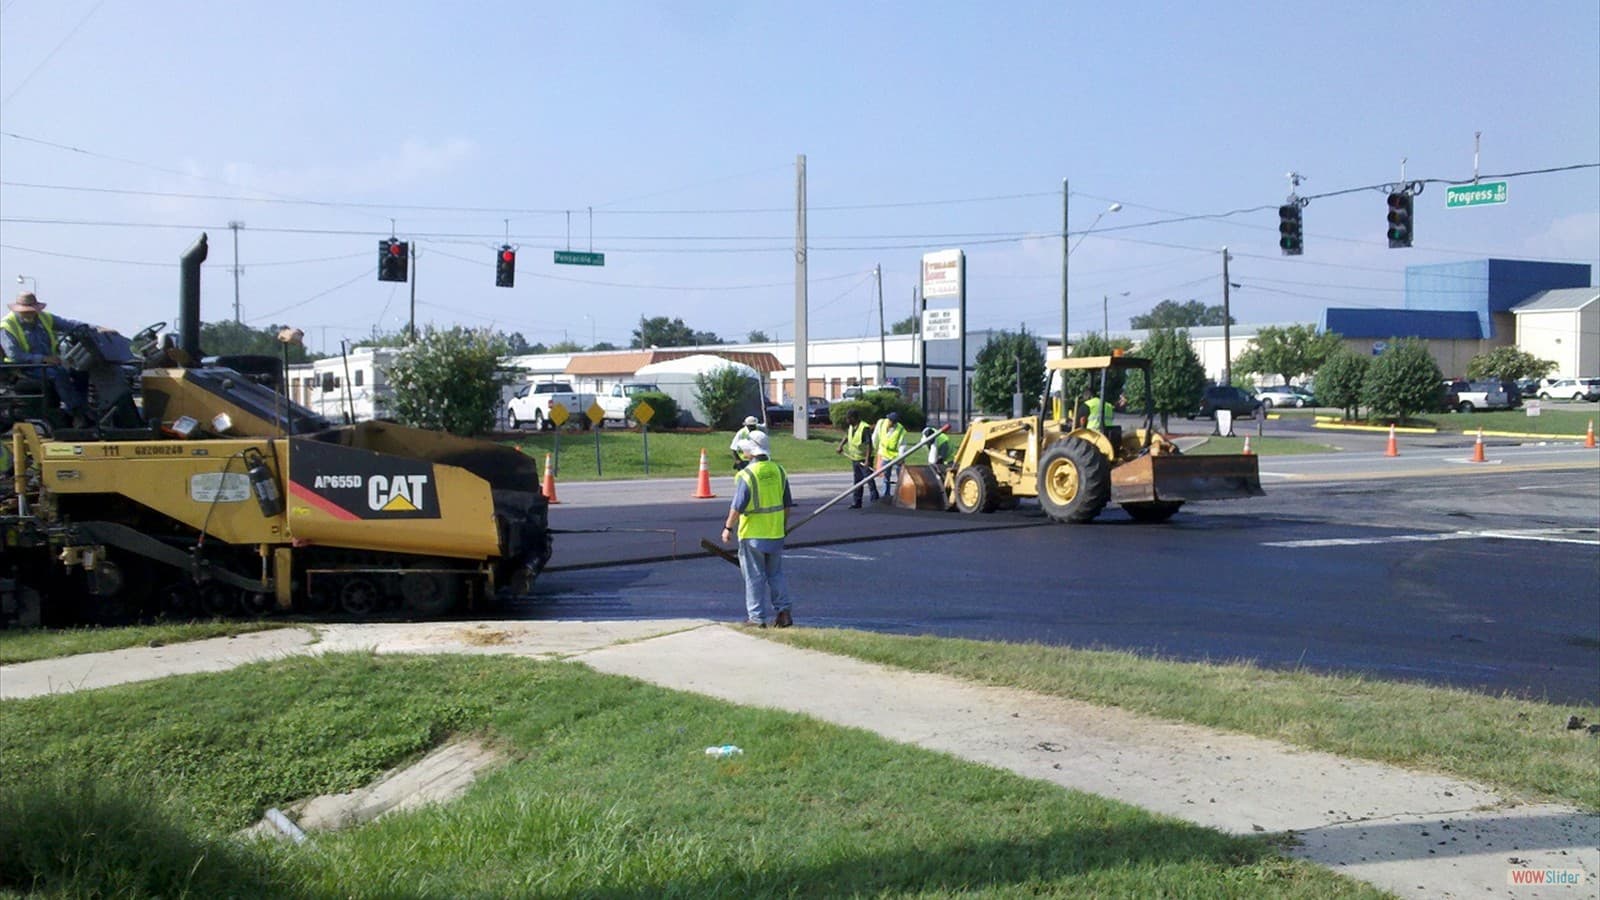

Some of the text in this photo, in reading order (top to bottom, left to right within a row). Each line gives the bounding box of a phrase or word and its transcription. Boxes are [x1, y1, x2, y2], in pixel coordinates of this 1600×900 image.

[1447, 189, 1493, 205] Progress
[314, 475, 362, 488] AP655D
[368, 475, 427, 511] CAT
